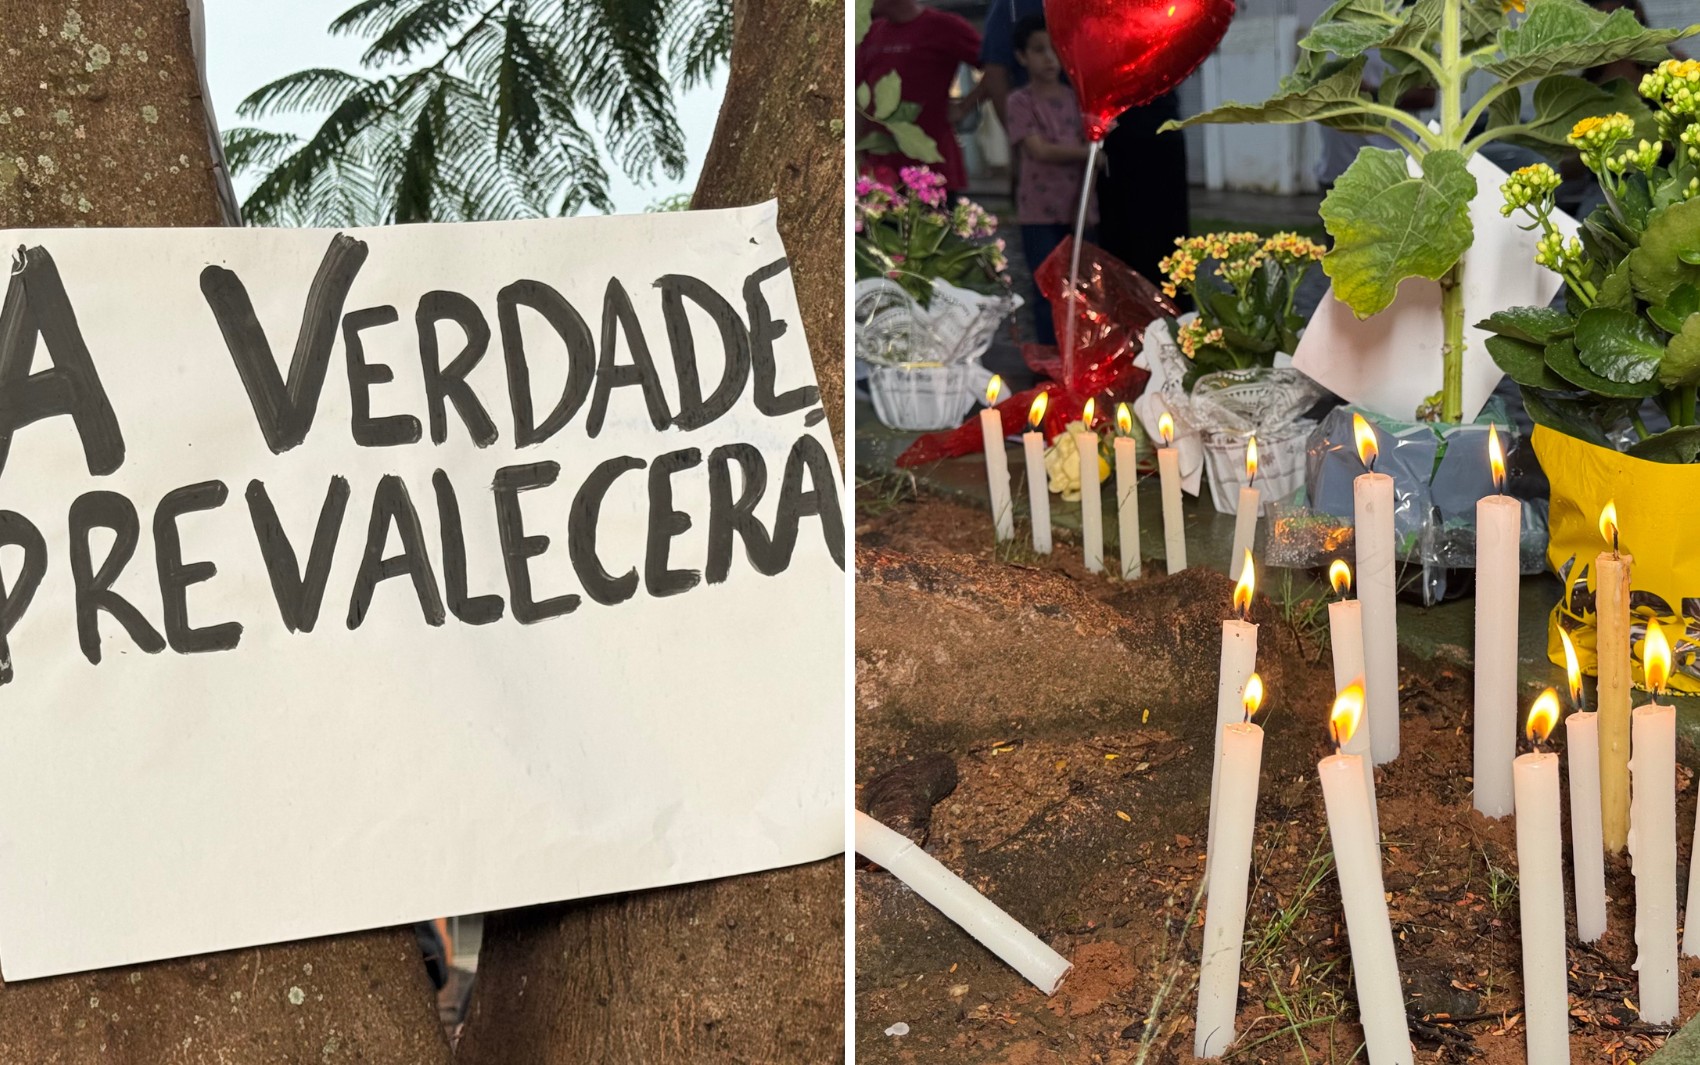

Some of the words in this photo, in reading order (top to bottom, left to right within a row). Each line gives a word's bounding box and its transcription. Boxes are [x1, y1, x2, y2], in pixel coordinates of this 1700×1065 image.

[0, 244, 125, 476] A
[200, 232, 821, 454] VERDADE
[0, 407, 845, 686] PREVALECERÁ
